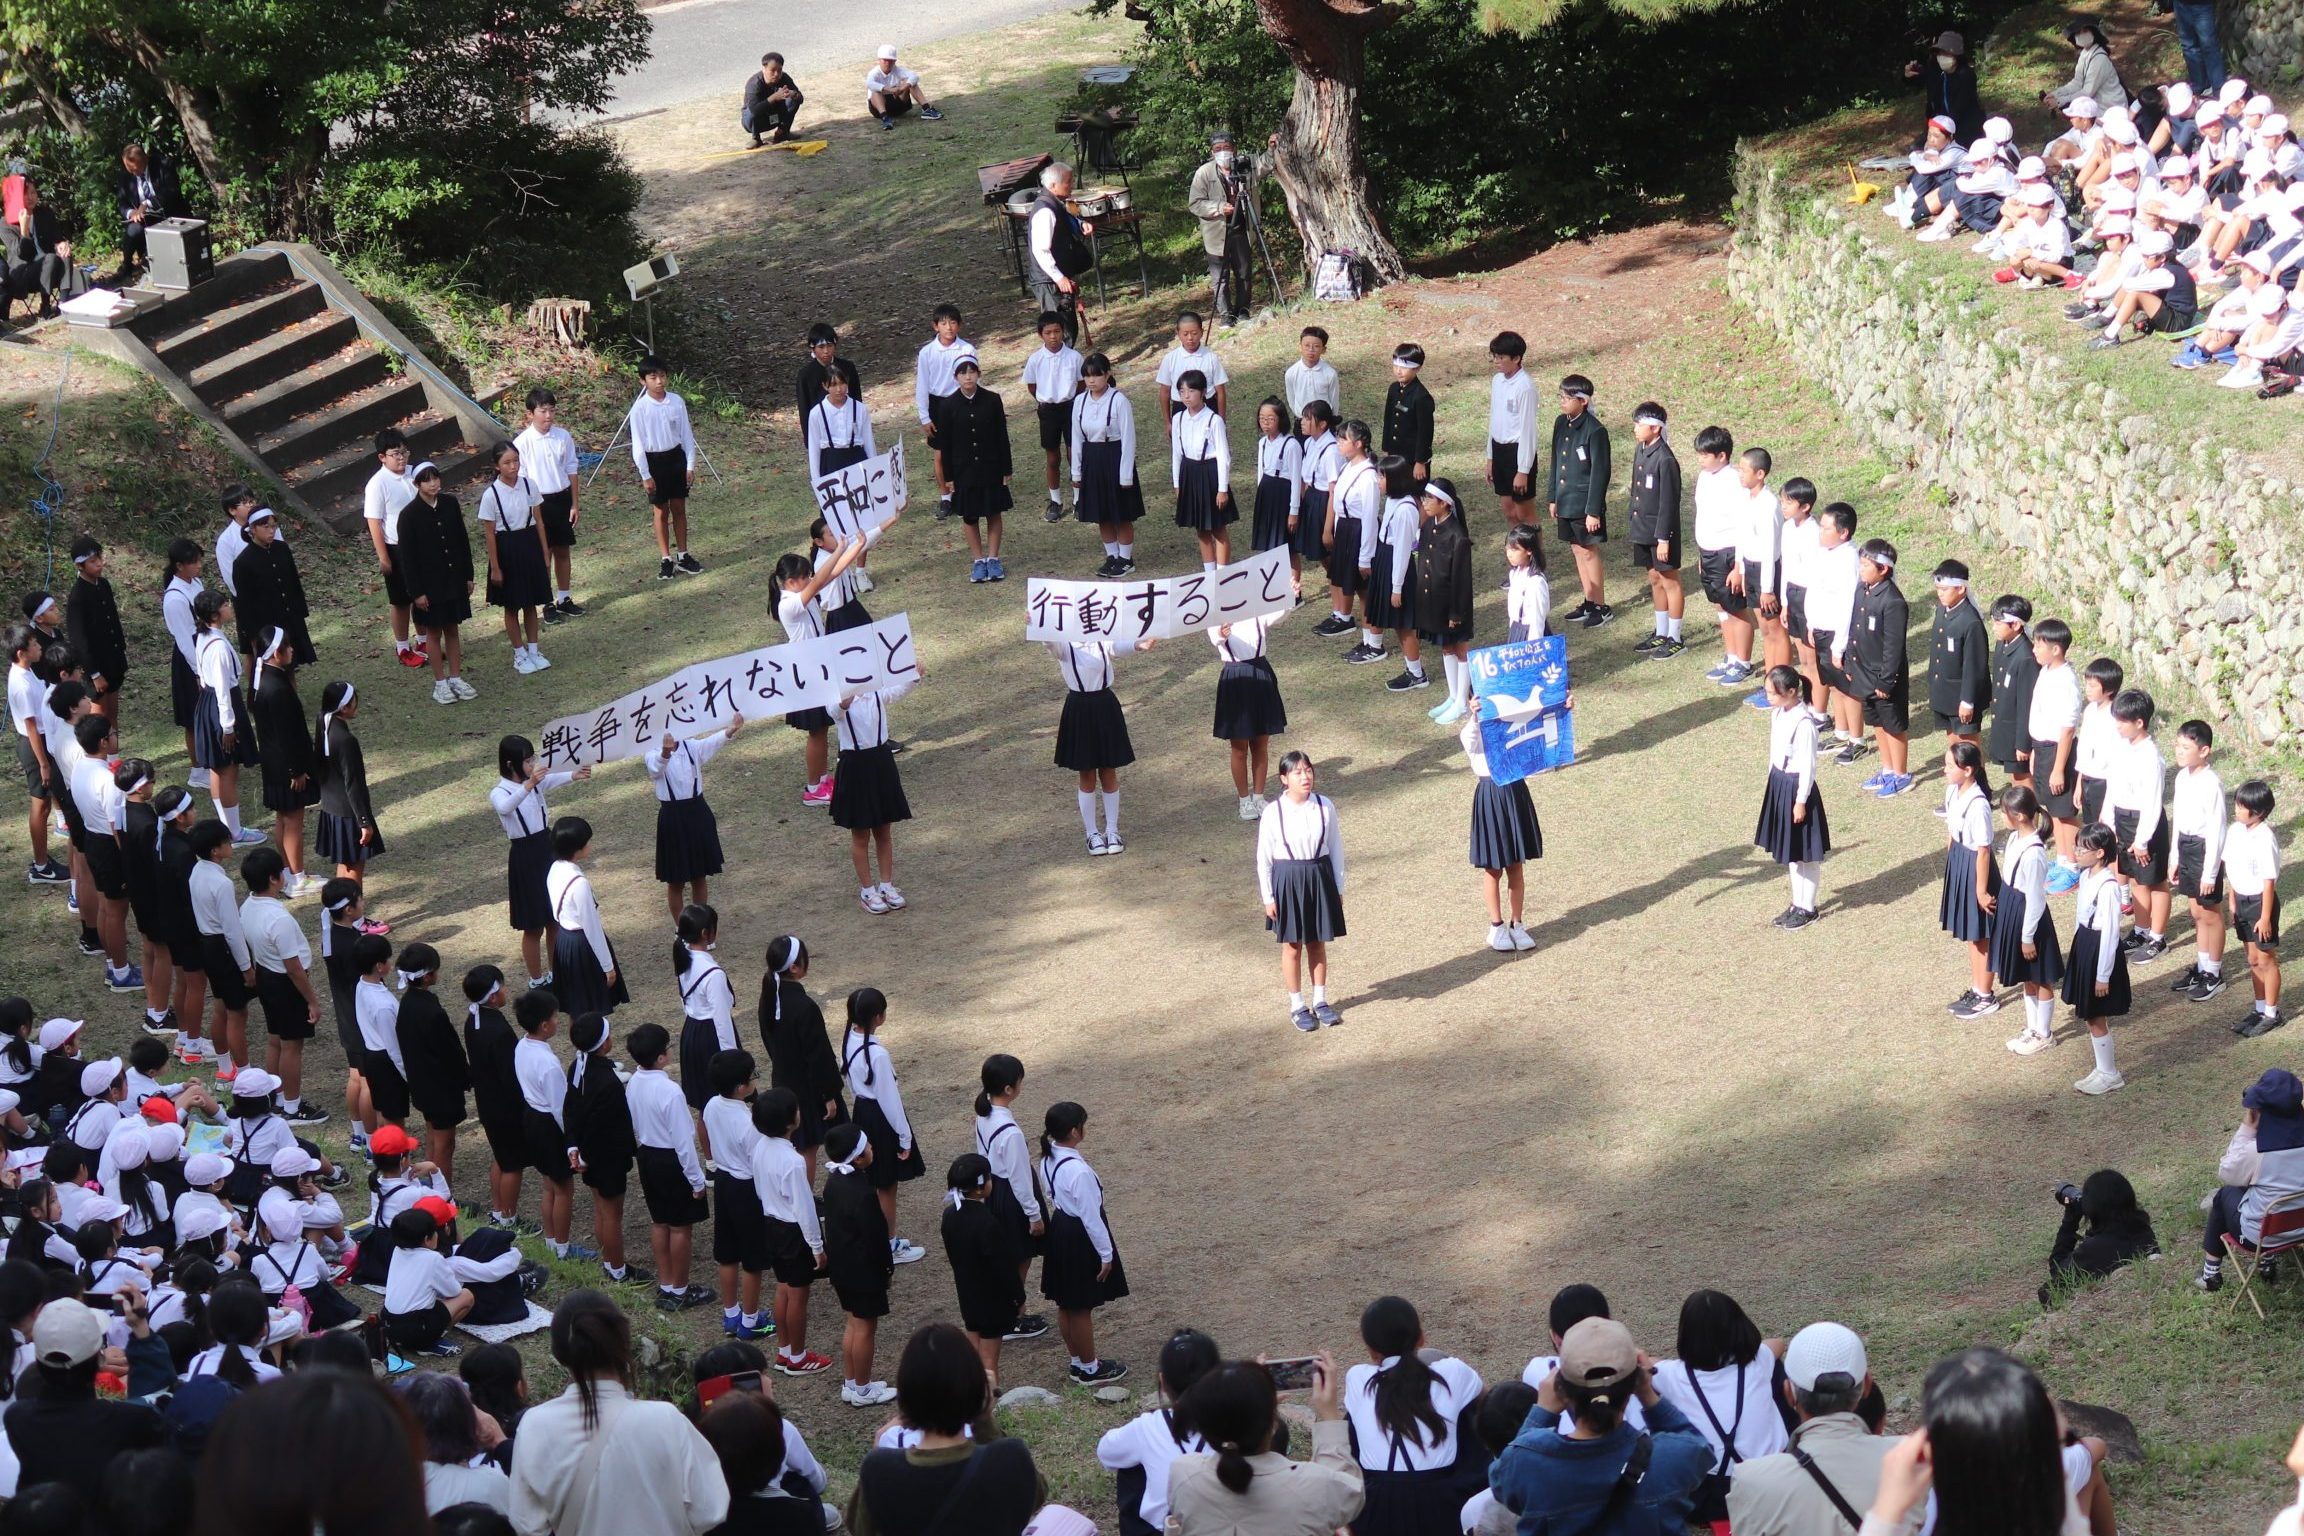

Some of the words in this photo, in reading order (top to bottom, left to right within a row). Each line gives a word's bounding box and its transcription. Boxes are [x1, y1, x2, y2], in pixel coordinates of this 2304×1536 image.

[1032, 561, 1286, 638] 行動すること
[541, 632, 916, 768] 戦争を忘れないこと
[1472, 651, 1498, 680] 16
